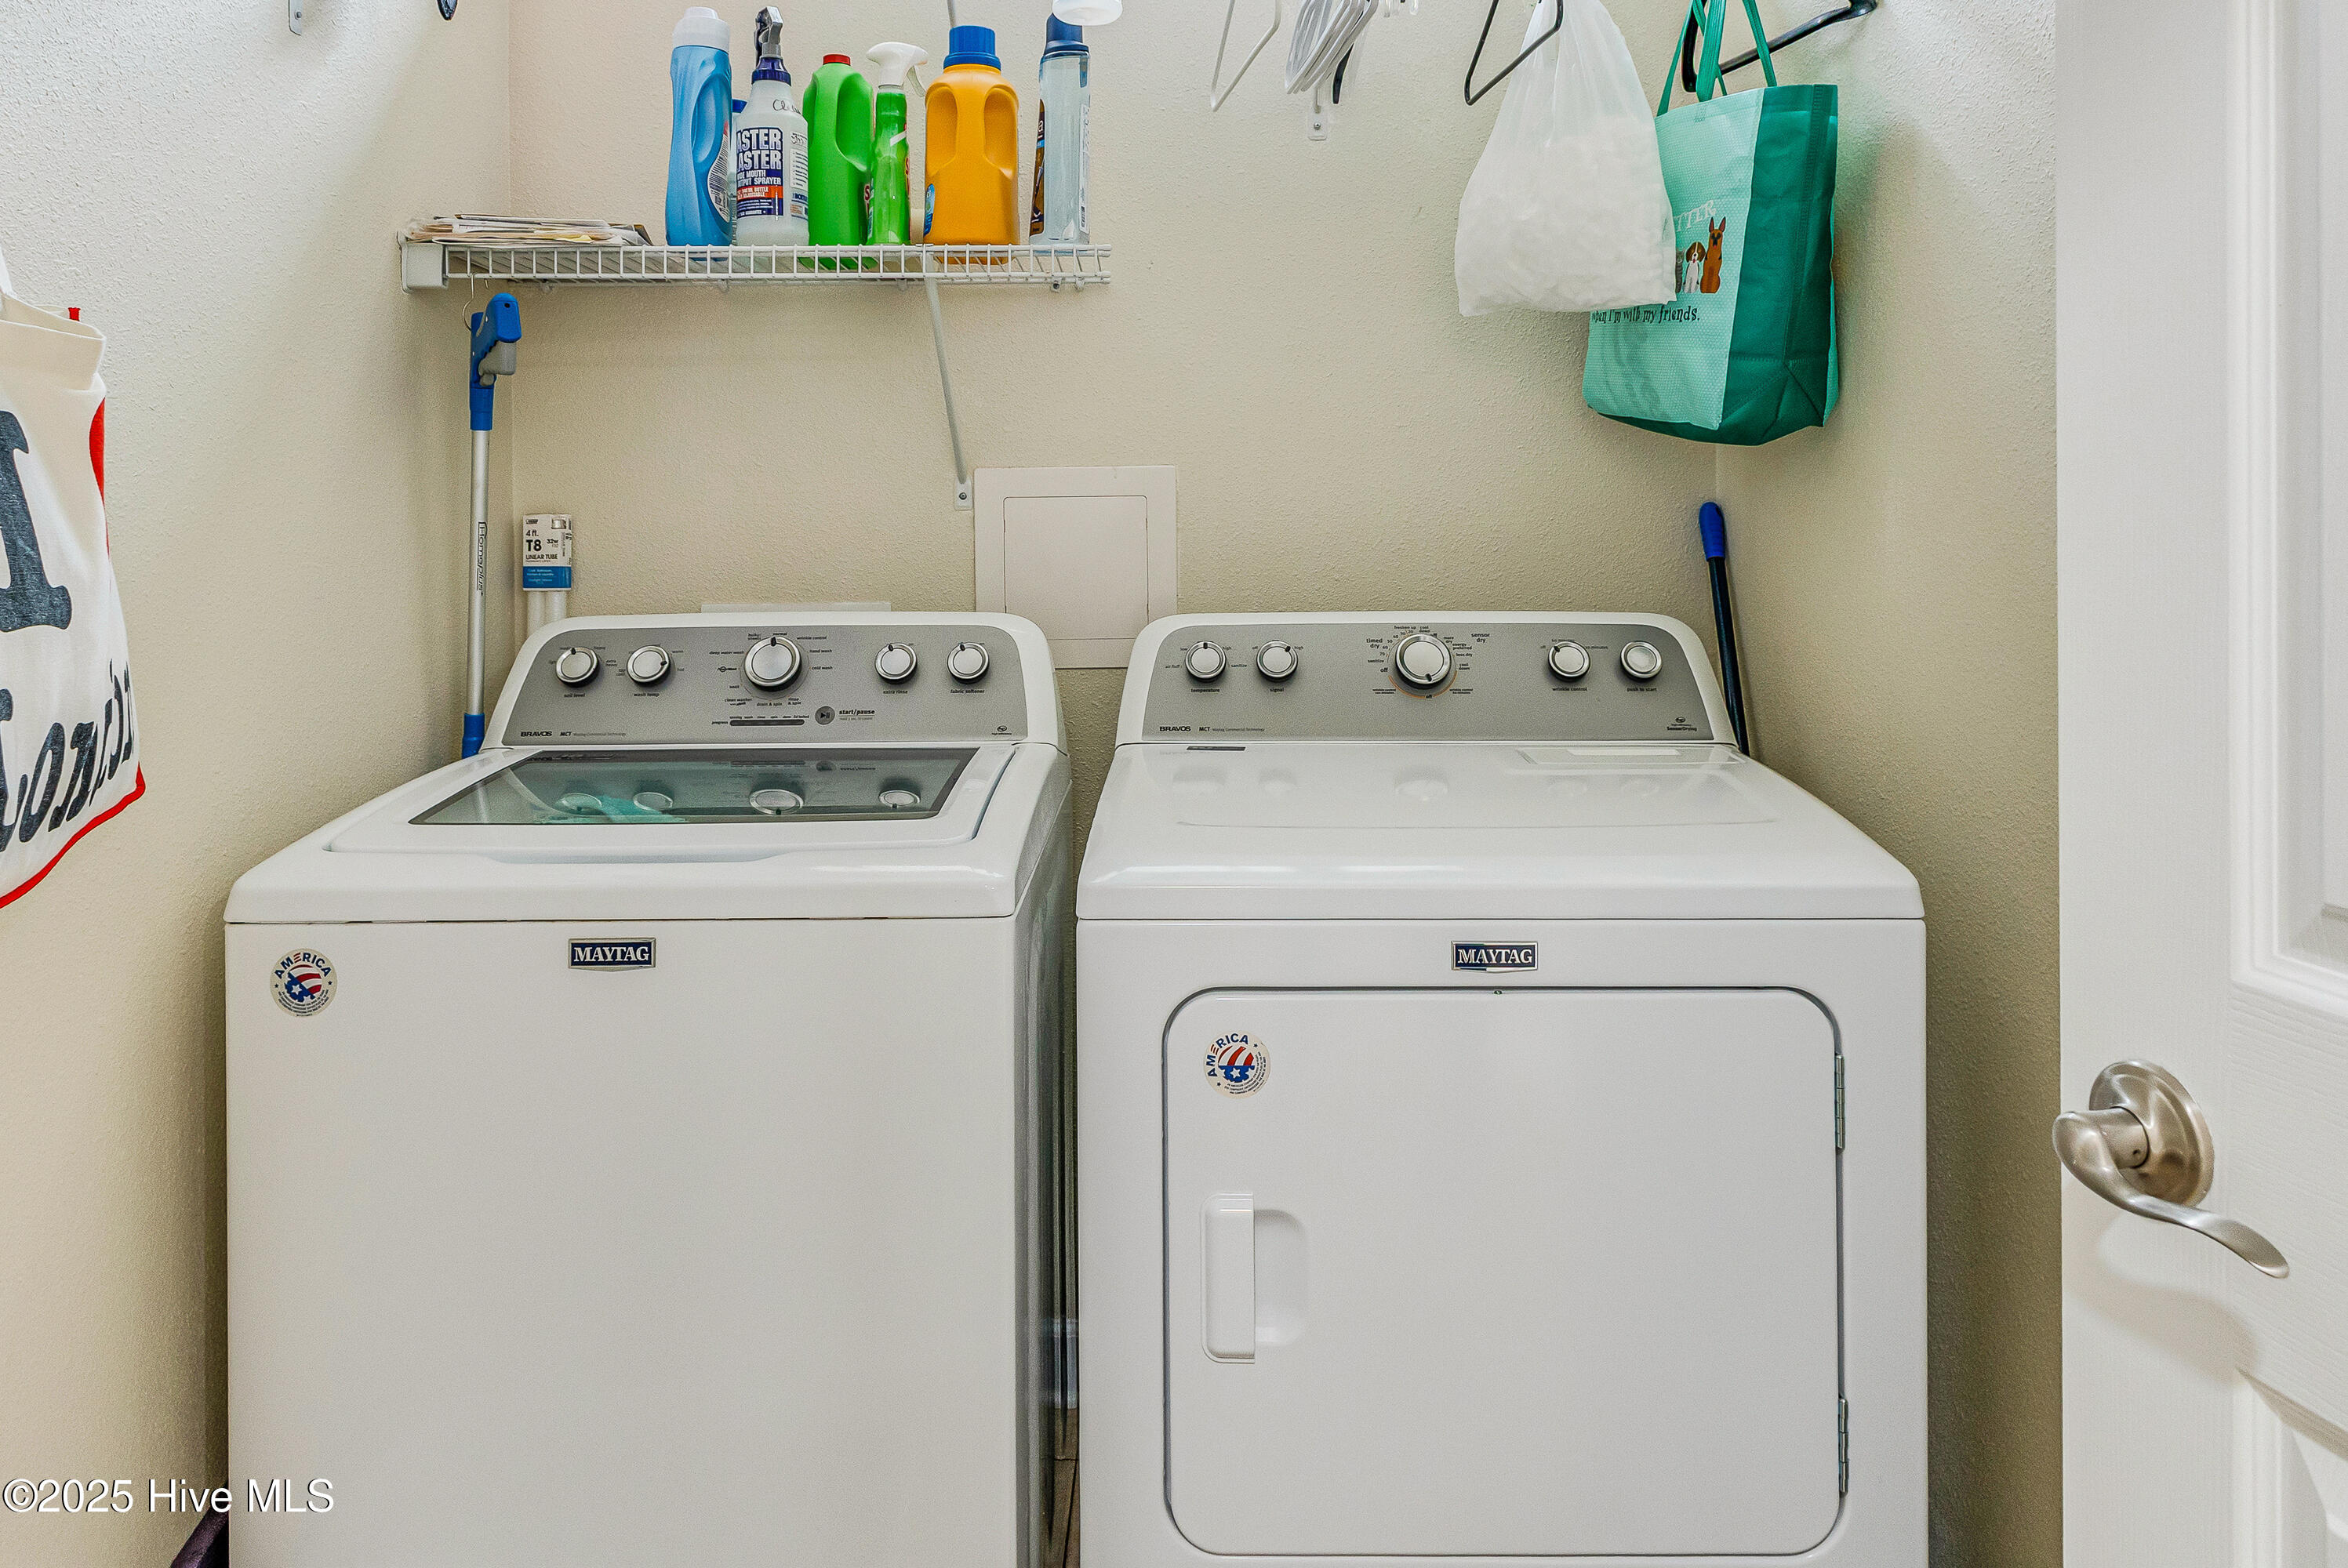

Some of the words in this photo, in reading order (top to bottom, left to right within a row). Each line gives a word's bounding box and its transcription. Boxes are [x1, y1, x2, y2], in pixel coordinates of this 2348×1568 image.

[1659, 305, 1700, 324] friends.
[525, 539, 542, 552] T8
[573, 946, 649, 962] MAYTAG
[1457, 949, 1533, 964] MAYTAG
[274, 952, 332, 979] AMERICA
[1206, 1033, 1249, 1077] AMERICA
